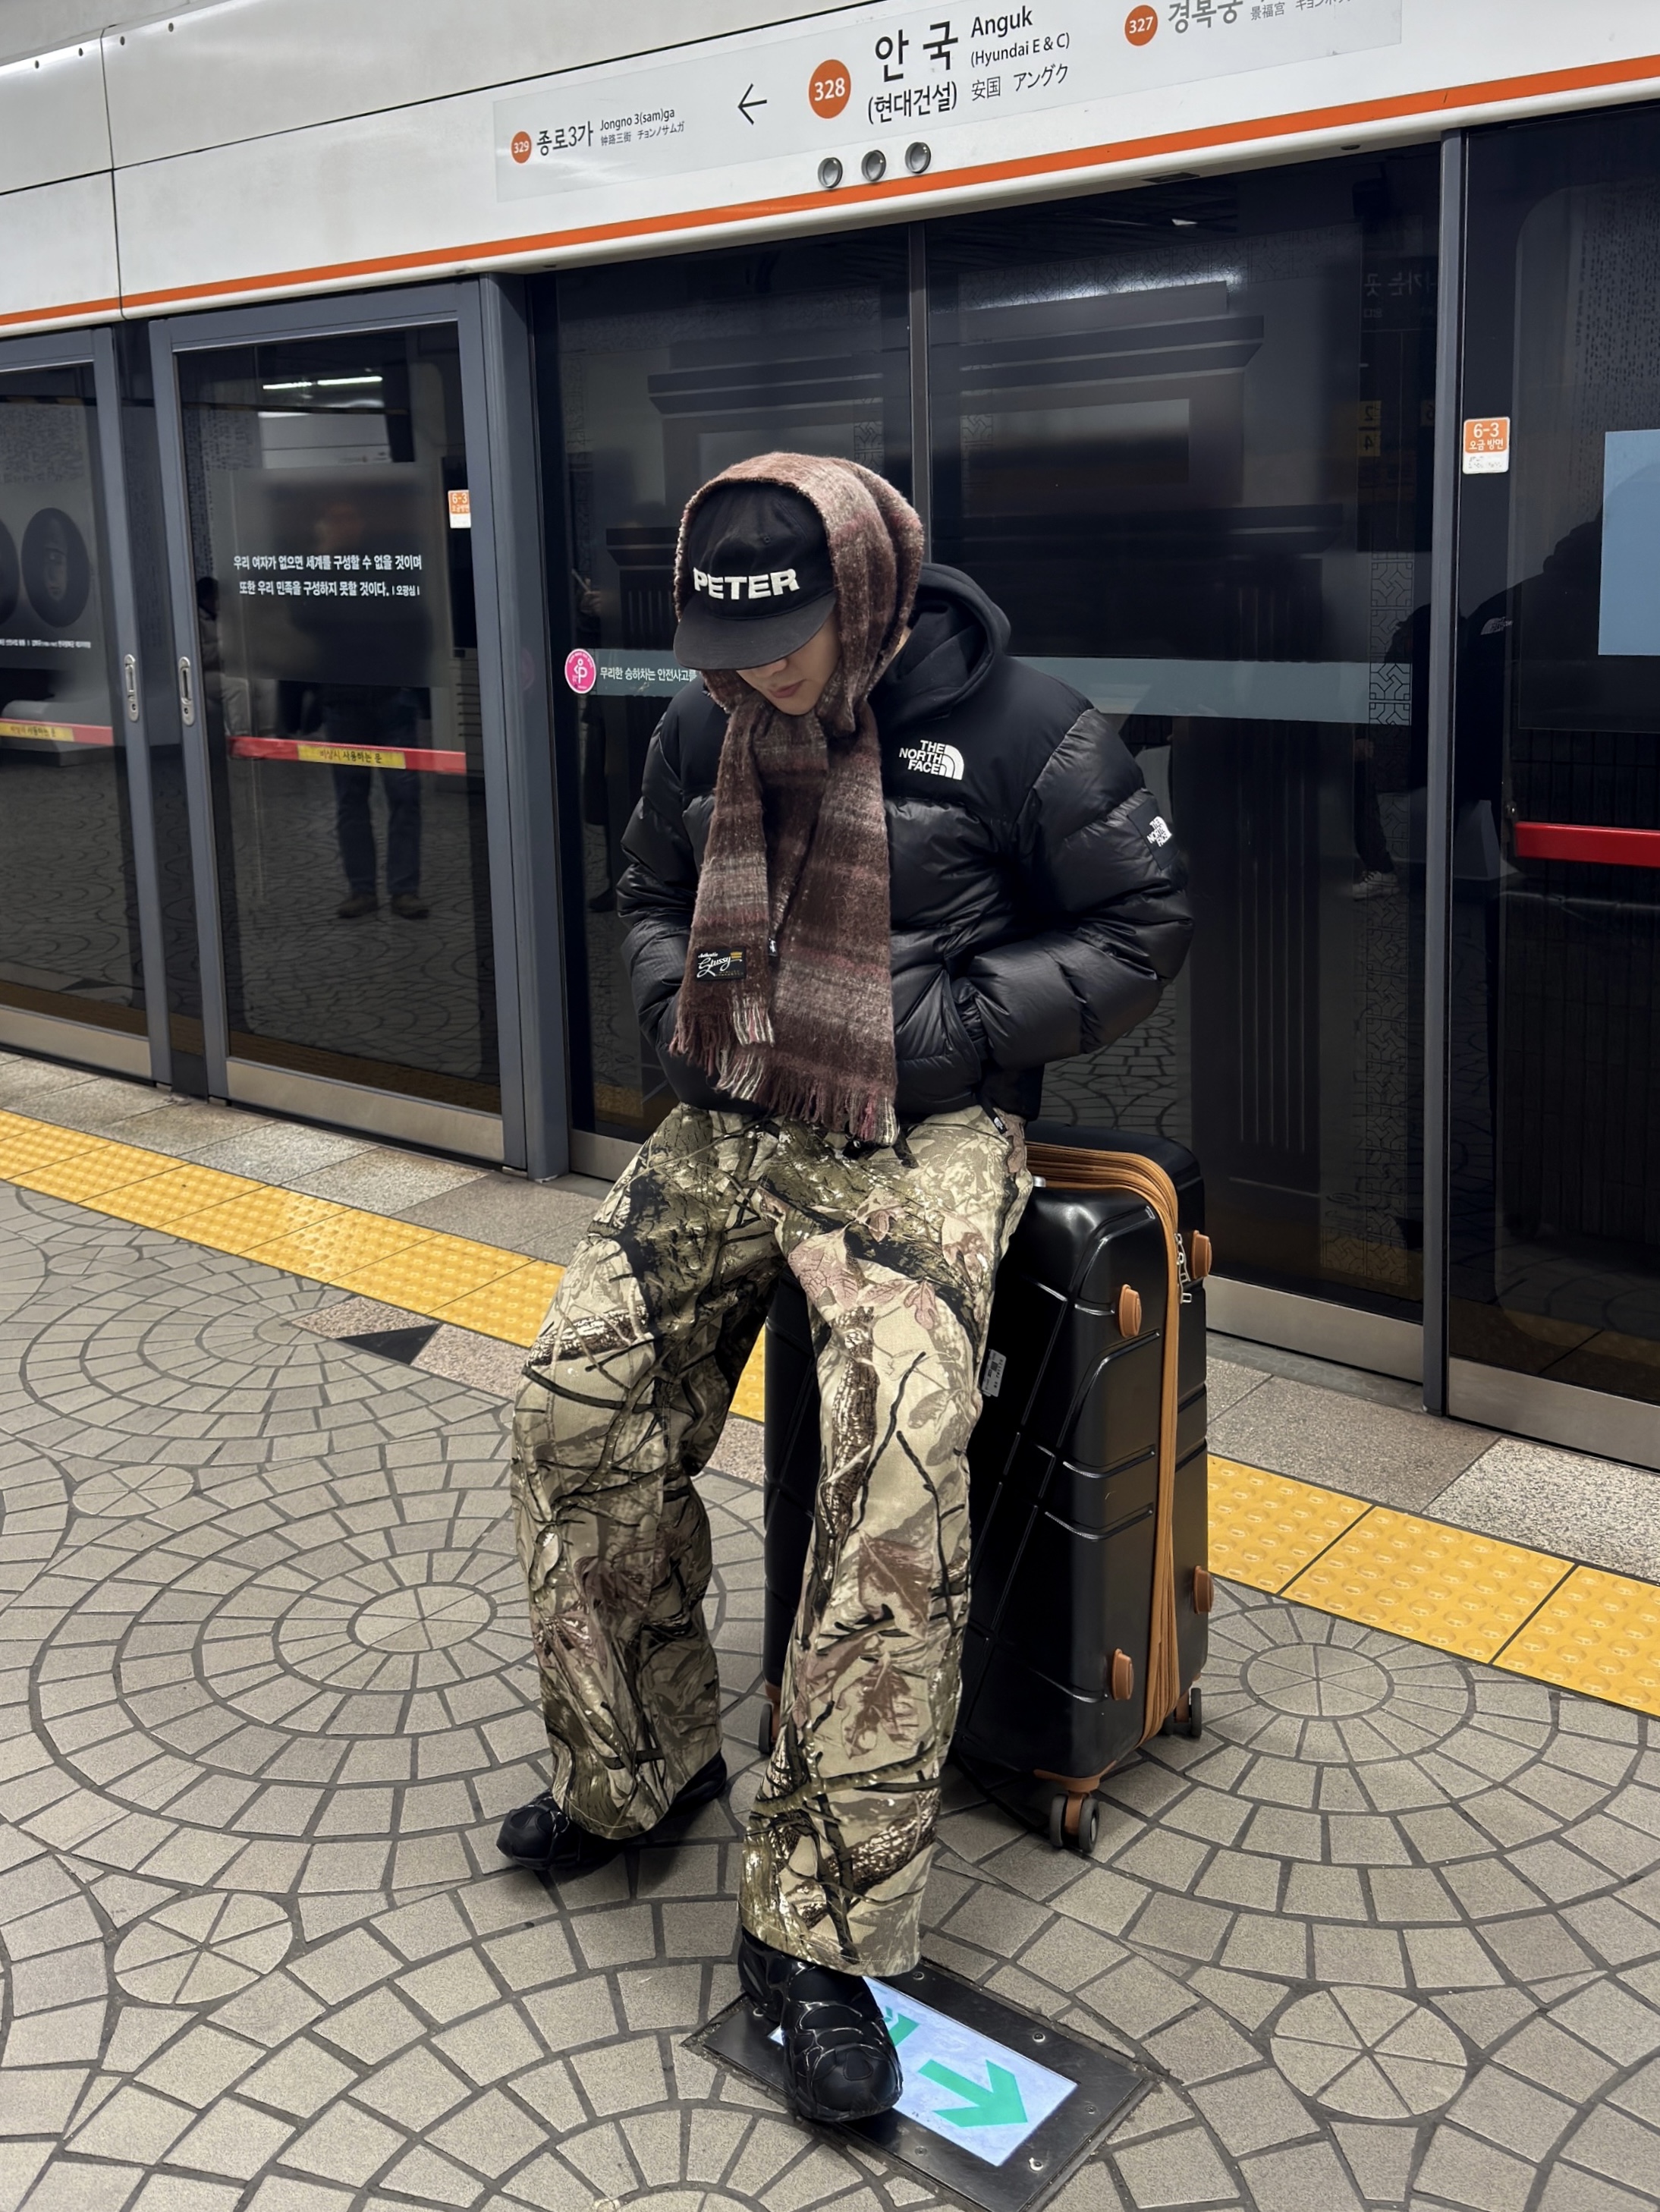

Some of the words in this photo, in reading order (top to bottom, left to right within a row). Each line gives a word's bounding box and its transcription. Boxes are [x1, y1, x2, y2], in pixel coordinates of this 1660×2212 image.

[971, 5, 1033, 38] Anguk
[1129, 16, 1154, 34] 327
[971, 40, 1029, 68] (Hyundai
[1033, 39, 1040, 53] E
[1043, 36, 1053, 51] &
[1056, 33, 1070, 49] C)
[1013, 63, 1068, 92] アングク
[814, 77, 845, 102] 328
[971, 75, 1001, 101] 安国
[868, 80, 957, 125] (현대건설)
[600, 117, 633, 131] Jongno
[634, 108, 675, 125] 3(sam)ga
[513, 140, 529, 154] 329
[536, 121, 593, 156] 종로3가
[1473, 422, 1499, 438] 6-3
[1469, 439, 1486, 451] 오금
[1487, 438, 1504, 450] 방면
[234, 555, 250, 571] 우리
[252, 555, 276, 571] 여자가
[278, 555, 303, 571] 없으면
[306, 555, 332, 571] 세계를
[333, 555, 360, 571] 구성할
[362, 555, 372, 571] 수
[374, 555, 392, 571] 없을
[395, 555, 422, 571] 것이며
[239, 581, 256, 595] 또한
[258, 581, 274, 596] 우리
[276, 581, 301, 596] 민족을
[303, 581, 338, 596] 구성하지
[339, 581, 357, 596] 못할
[360, 581, 389, 596] 것이다.
[693, 567, 800, 600] PETER
[599, 666, 623, 680] 무리한
[624, 667, 656, 681] 승하차는
[657, 668, 697, 682] 안전사고를
[899, 747, 942, 764] NORTH
[920, 739, 945, 754] THE
[907, 760, 941, 775] FACE
